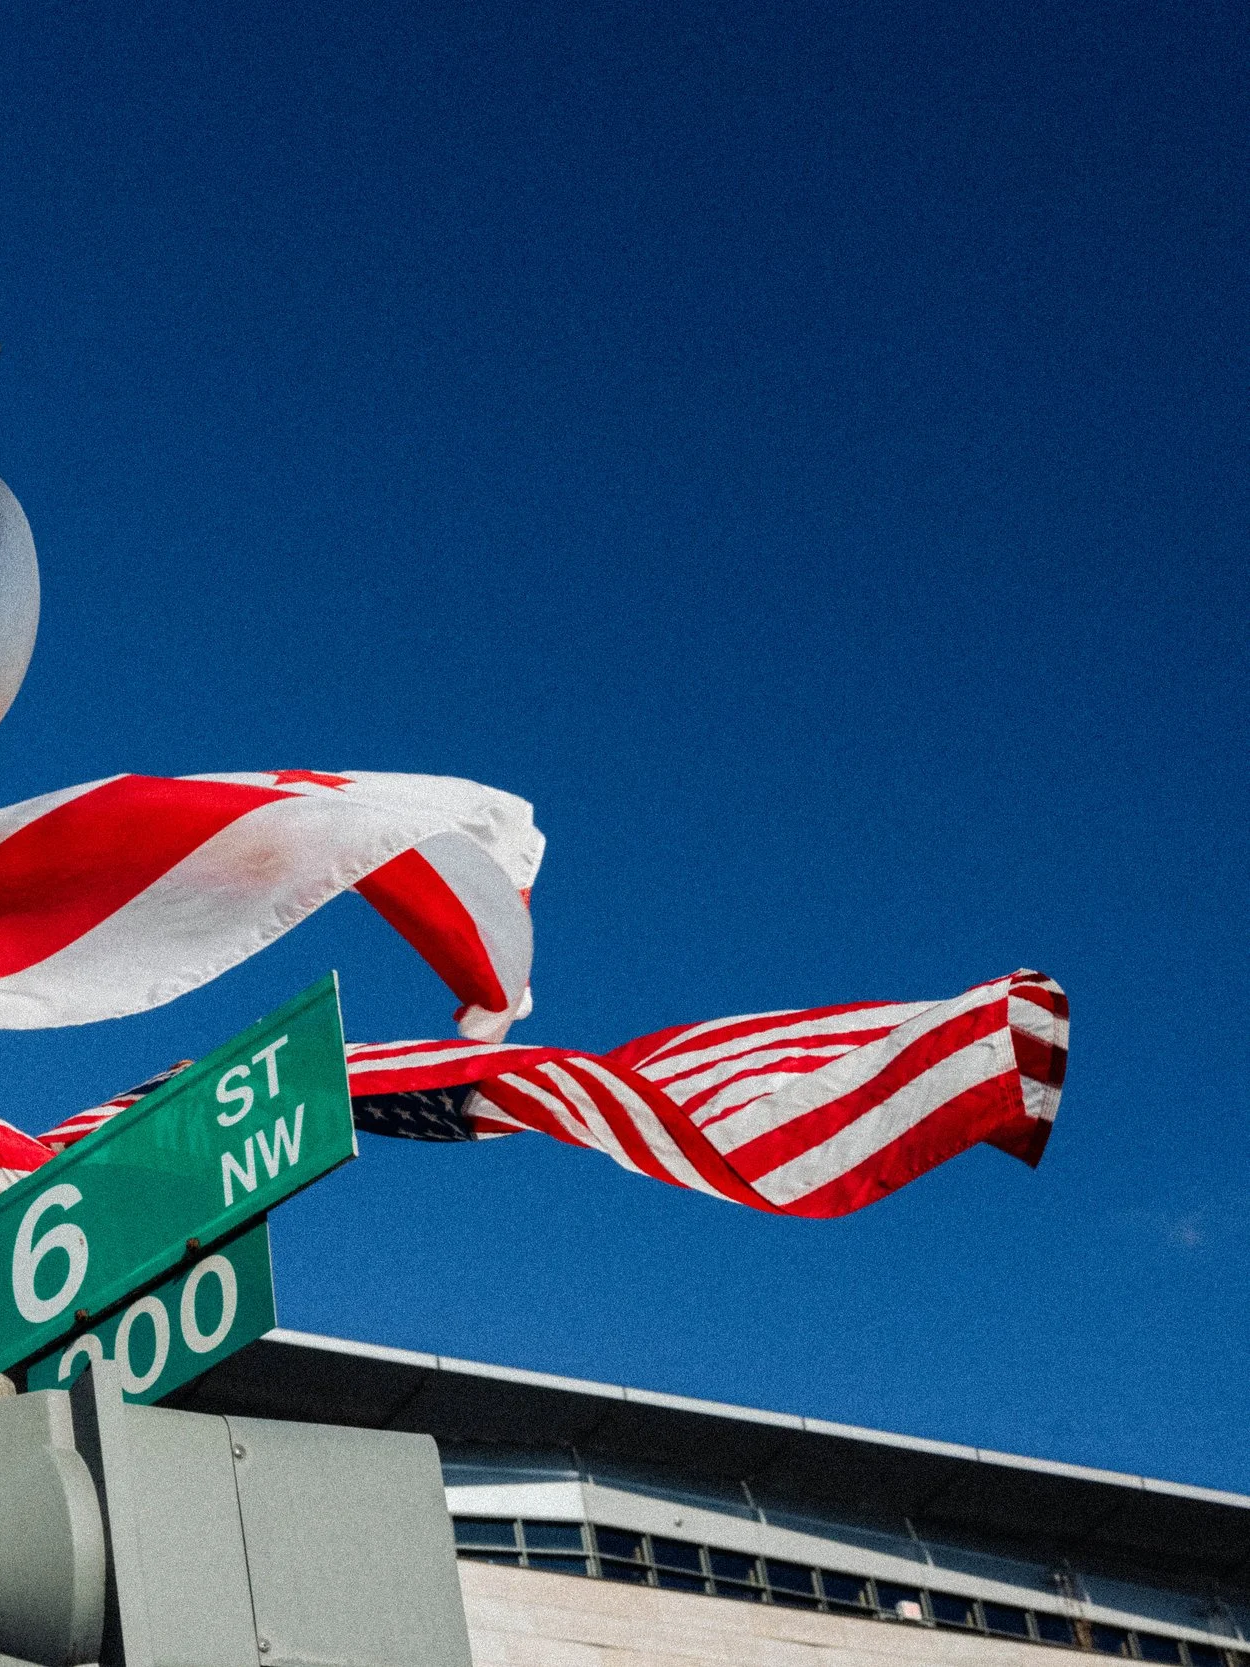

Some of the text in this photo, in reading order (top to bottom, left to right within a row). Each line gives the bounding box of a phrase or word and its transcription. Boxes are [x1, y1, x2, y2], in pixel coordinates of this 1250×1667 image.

[216, 1035, 289, 1127] ST
[221, 1103, 306, 1207] NW
[11, 1183, 89, 1324] 6
